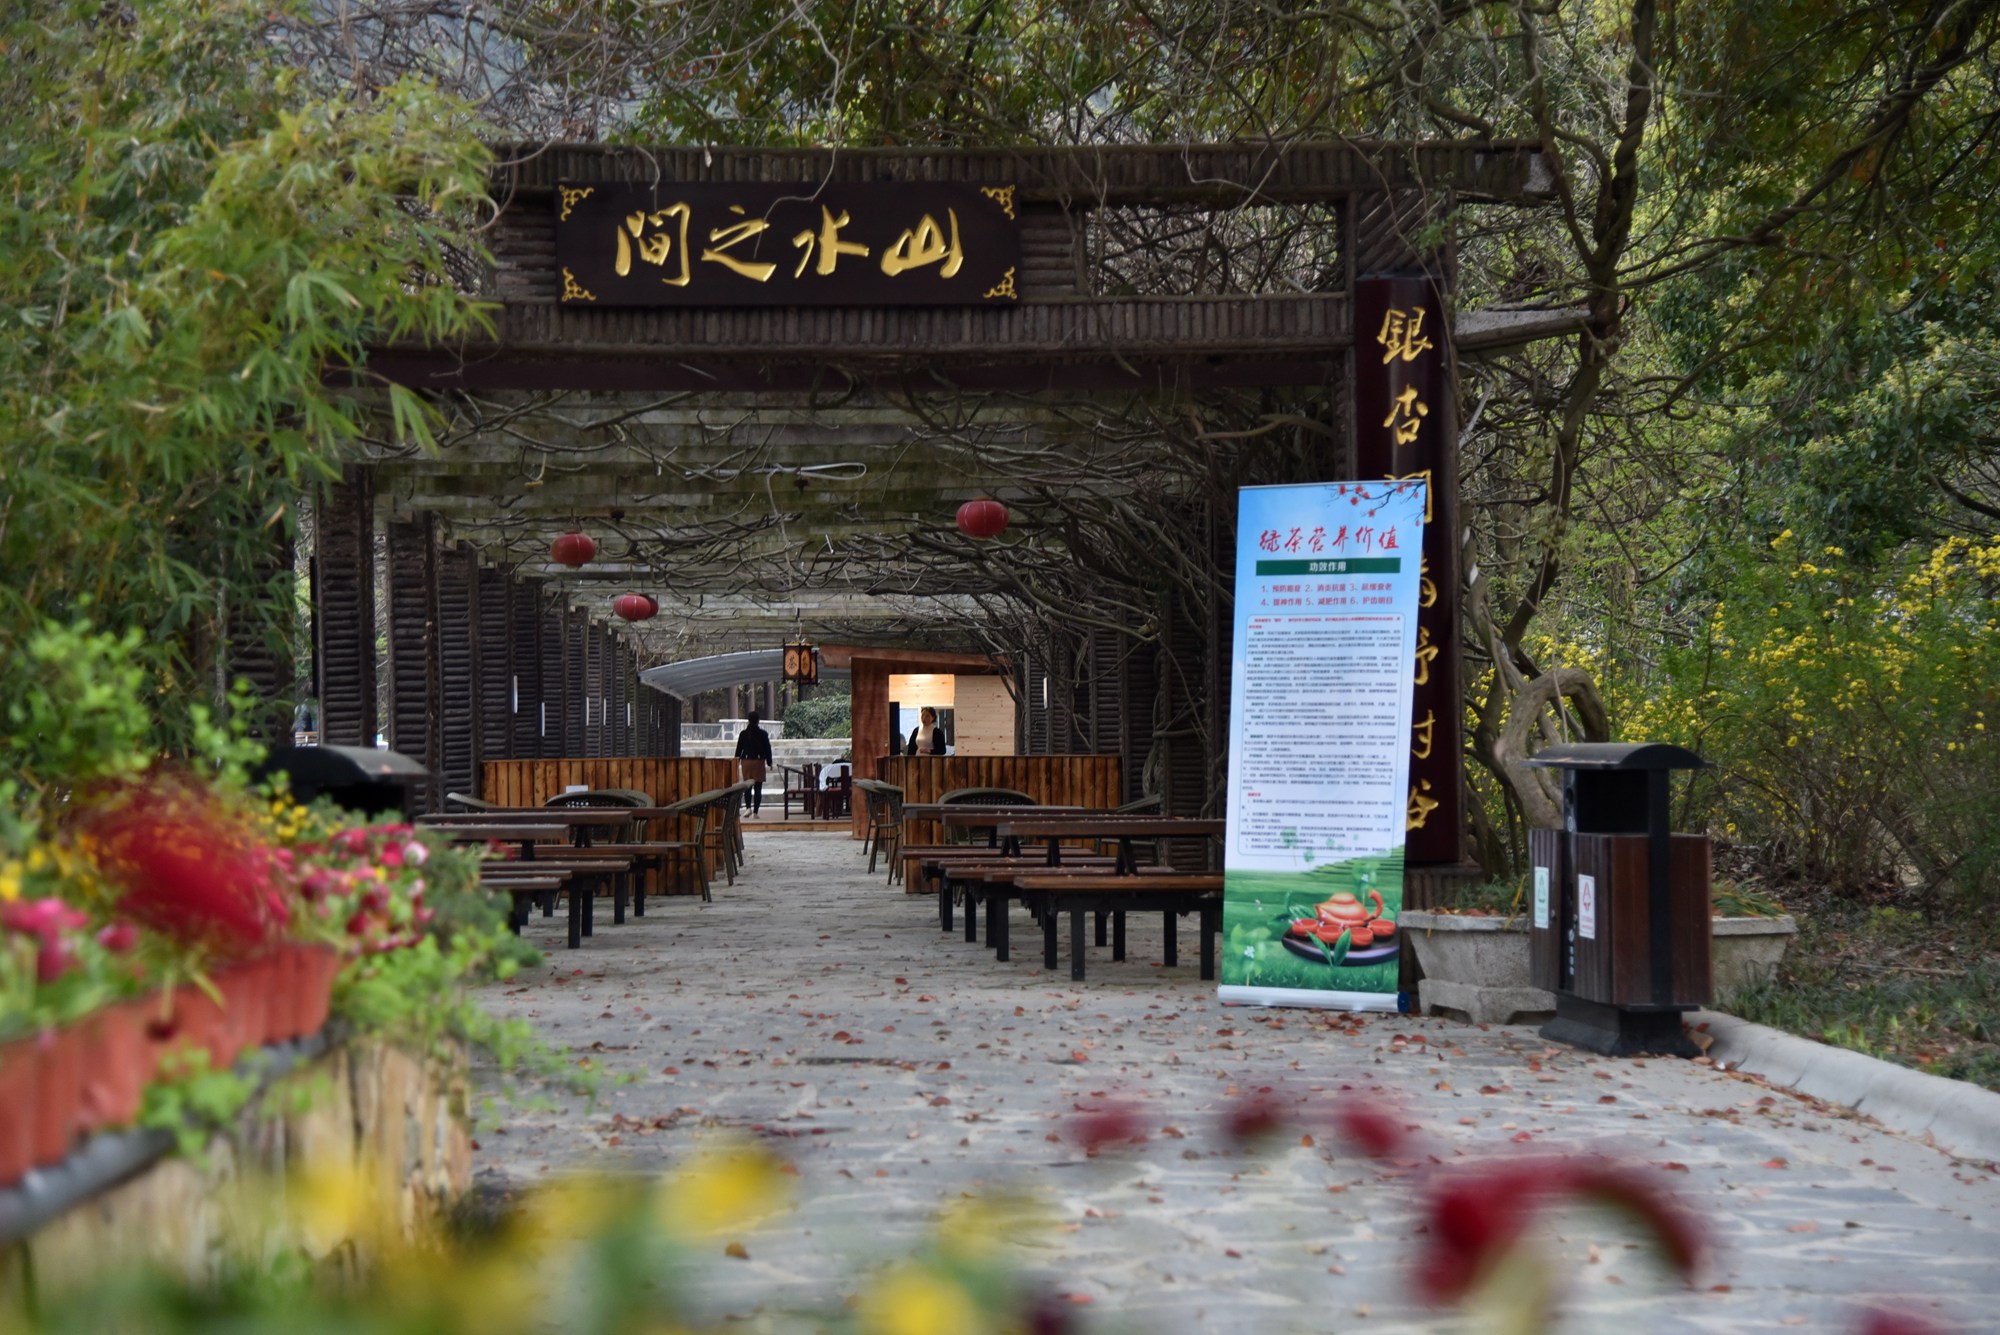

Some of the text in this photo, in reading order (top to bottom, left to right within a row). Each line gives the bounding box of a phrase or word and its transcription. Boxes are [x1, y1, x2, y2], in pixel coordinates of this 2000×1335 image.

[1259, 524, 1400, 553] 绿茶营养价值
[1309, 561, 1347, 572] 功效作用
